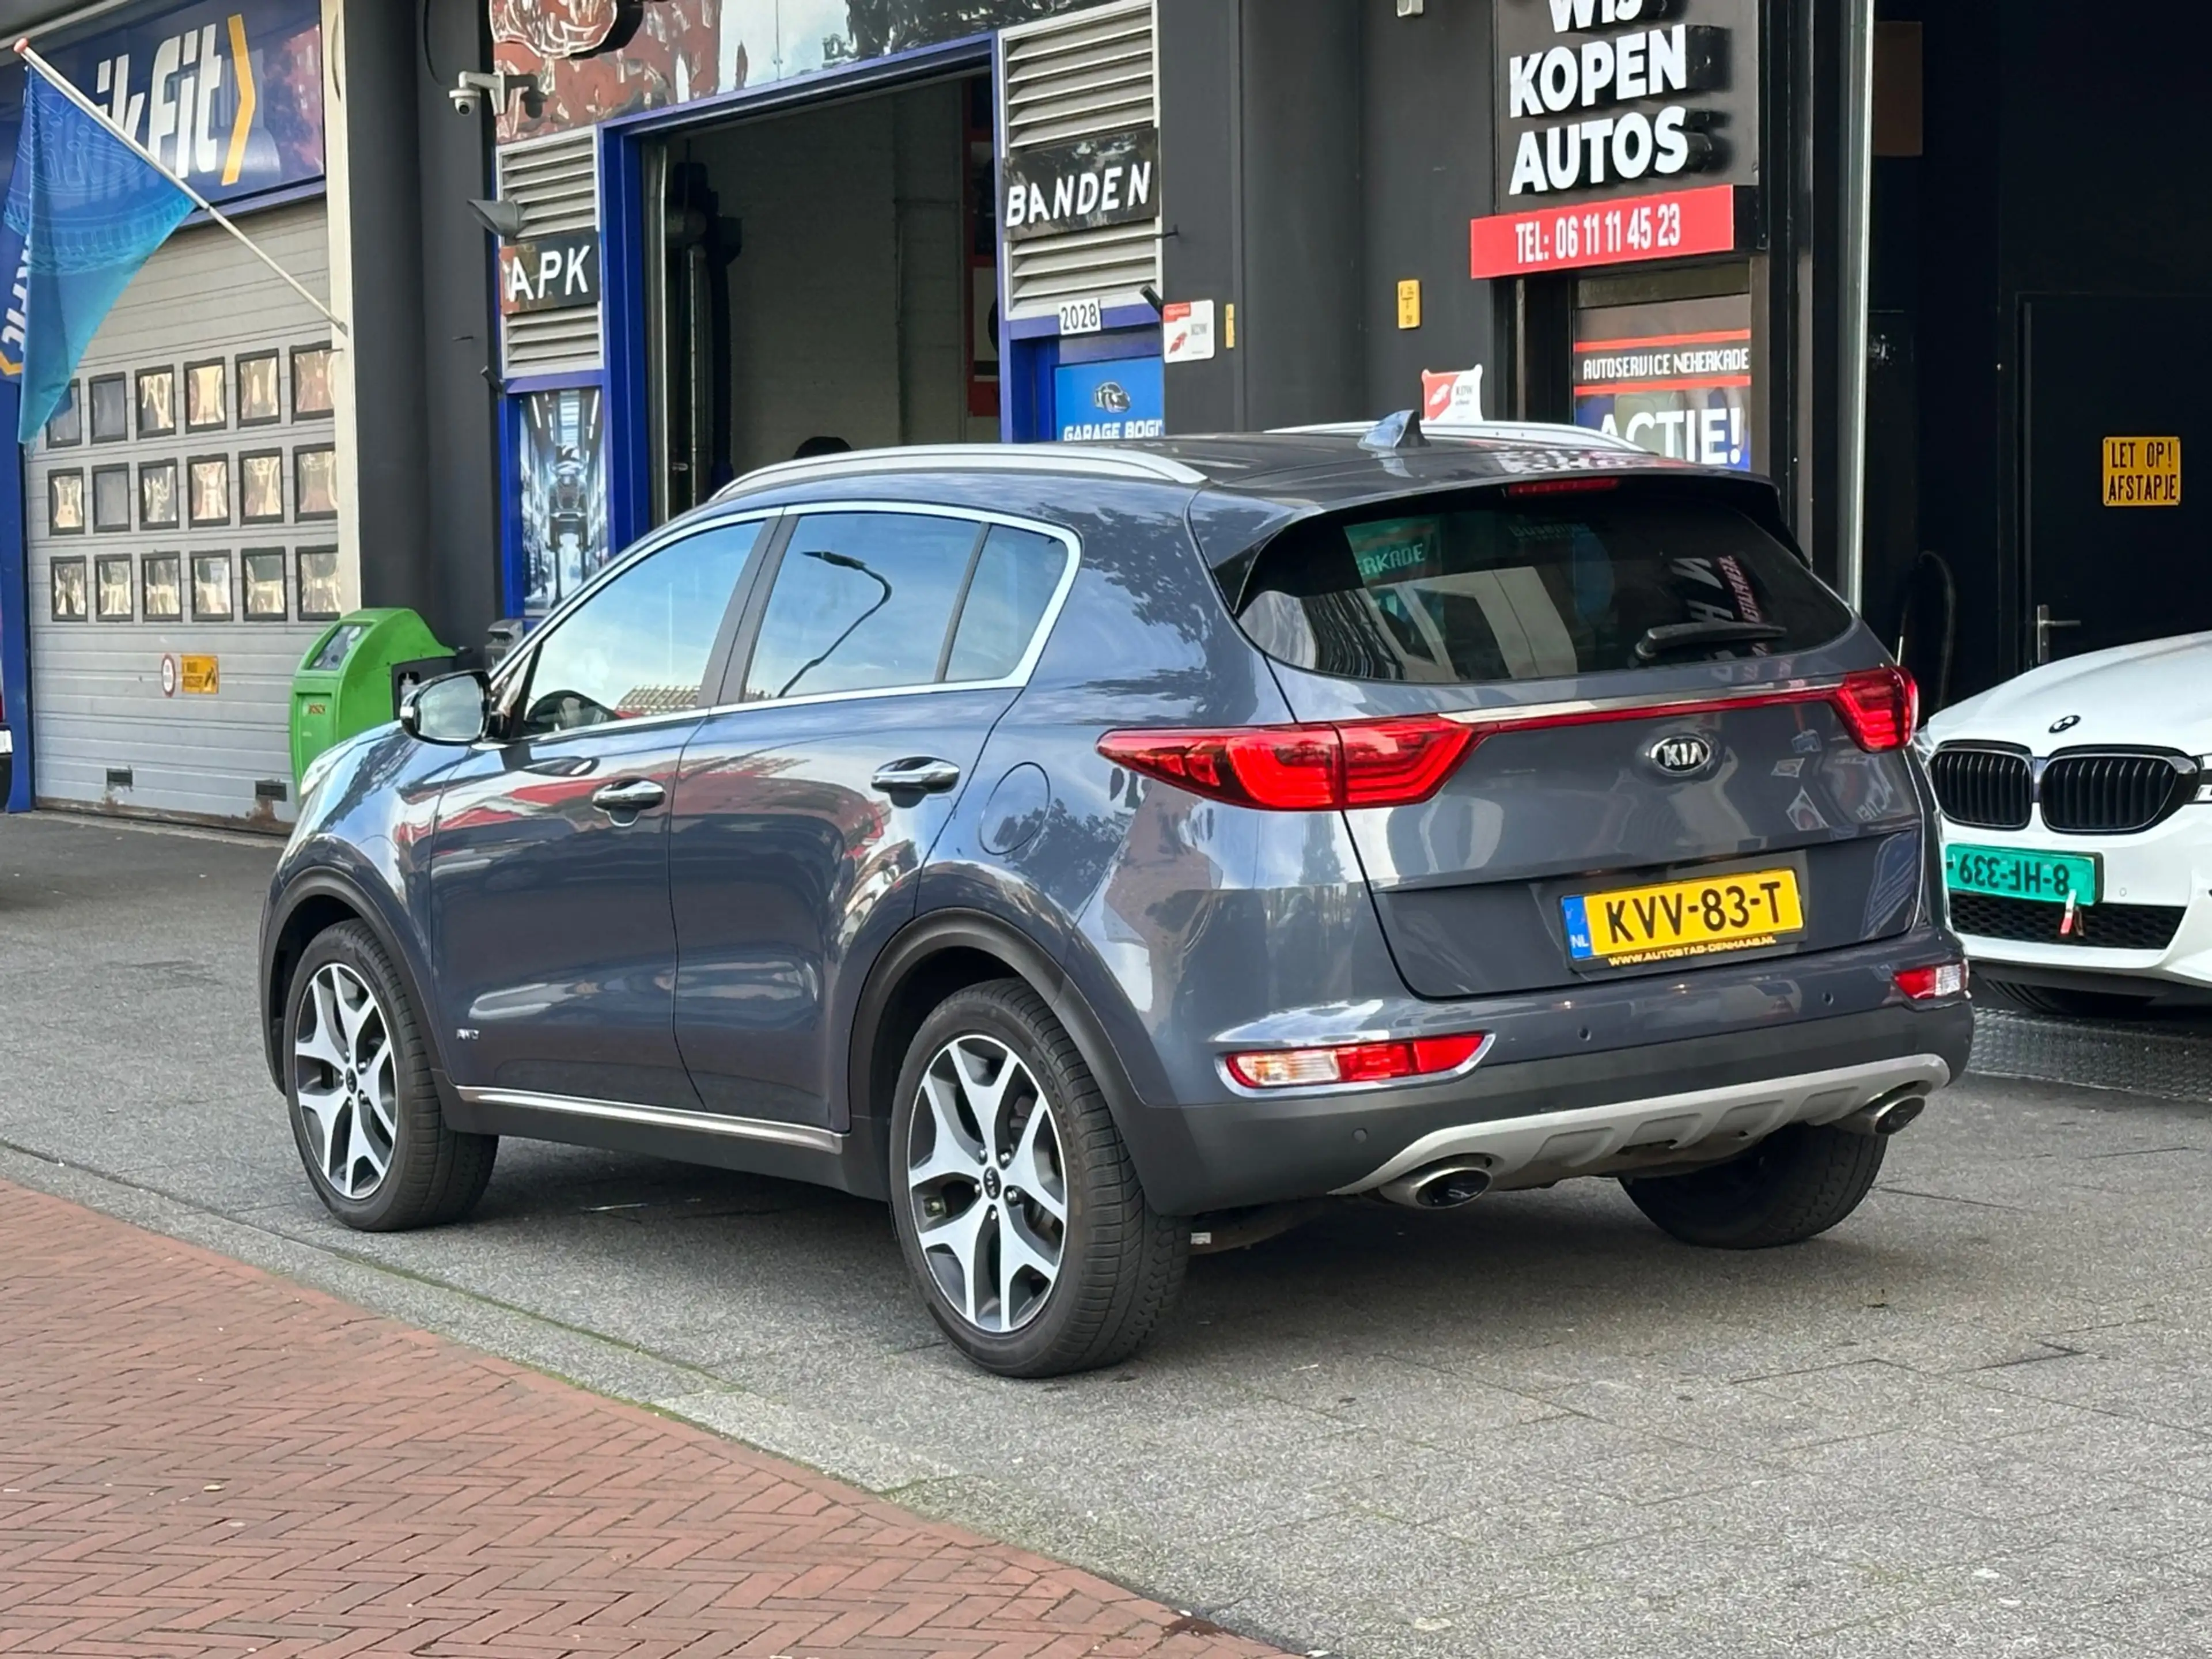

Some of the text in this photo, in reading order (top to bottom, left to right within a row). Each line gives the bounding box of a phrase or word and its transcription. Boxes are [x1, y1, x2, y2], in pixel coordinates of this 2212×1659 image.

[1510, 24, 1686, 118] KOPEN
[1509, 106, 1688, 195] AUTOS
[1006, 161, 1151, 227] BANDEN
[1516, 203, 1680, 264] TEL: 06 11 11 45 23
[508, 245, 591, 302] APK
[1061, 303, 1097, 331] 2028
[1584, 354, 1671, 380] AUTOSERVICE
[1063, 422, 1120, 442] GARAGE
[2111, 441, 2171, 468] LET OP!
[2108, 474, 2177, 501] AFSTAPJE
[1662, 742, 1705, 767] KIA
[1606, 881, 1781, 944] KVV-83-T
[1571, 934, 1589, 948] NL
